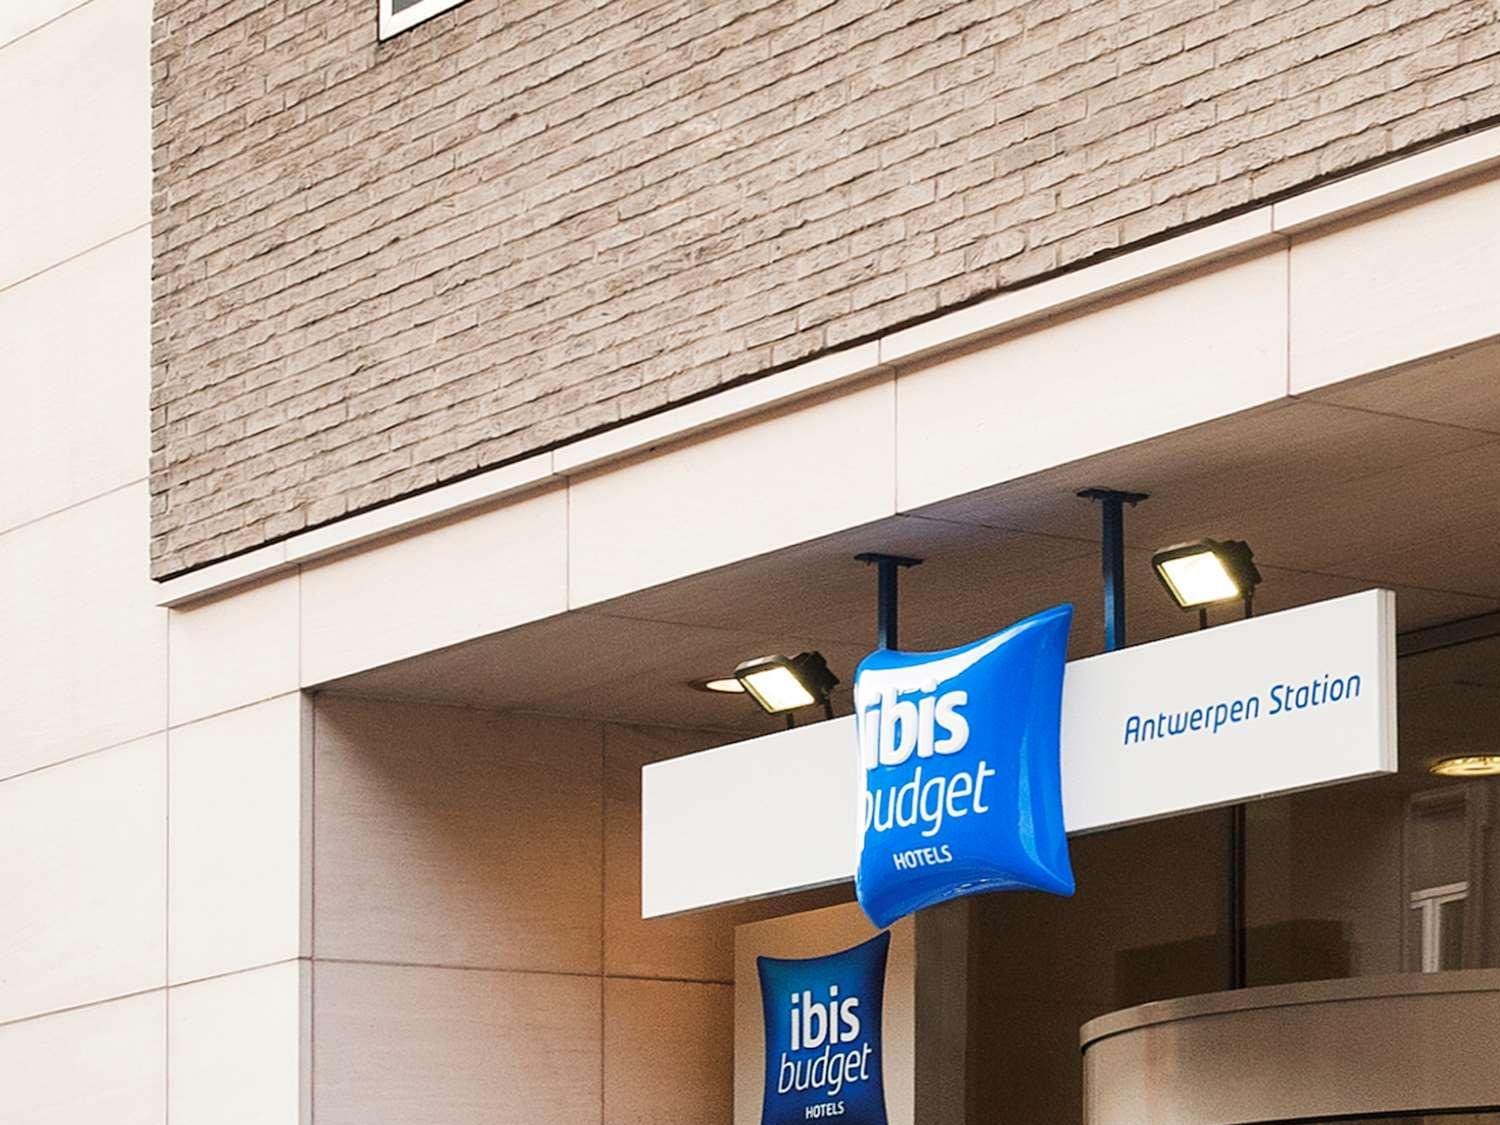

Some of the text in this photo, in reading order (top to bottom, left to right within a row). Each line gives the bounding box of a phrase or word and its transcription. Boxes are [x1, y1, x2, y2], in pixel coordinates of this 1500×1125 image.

[863, 679, 970, 771] ibis
[1124, 673, 1361, 746] Antwerpen Station
[892, 844, 953, 871] HOTELS
[790, 985, 861, 1051] ibis
[777, 1042, 872, 1096] budget
[805, 1101, 845, 1120] HOTELS
